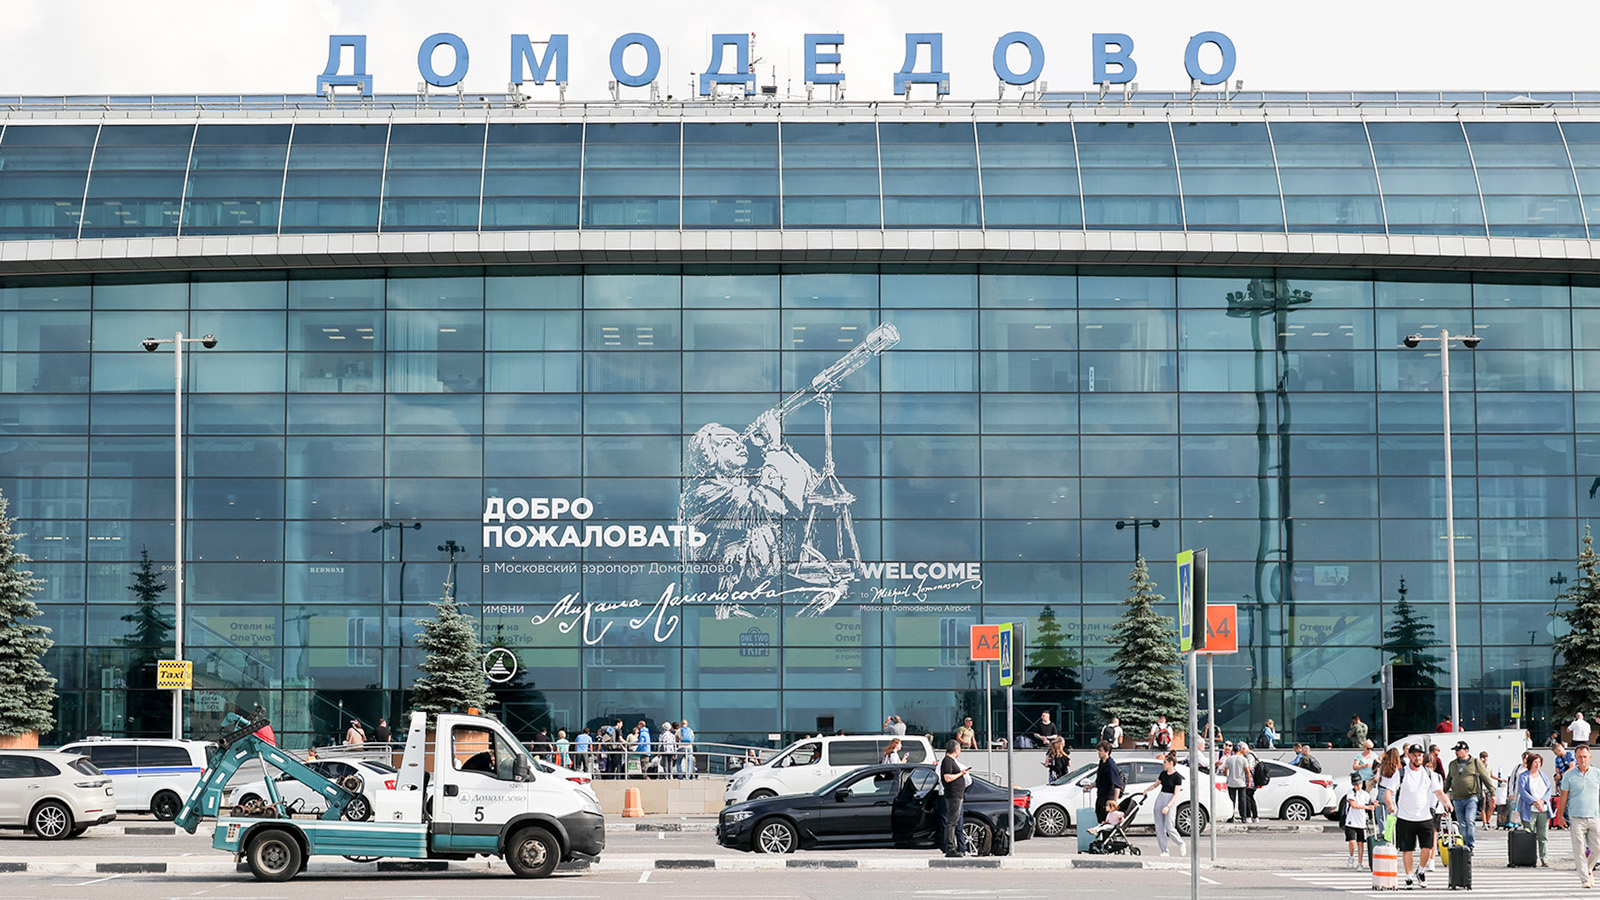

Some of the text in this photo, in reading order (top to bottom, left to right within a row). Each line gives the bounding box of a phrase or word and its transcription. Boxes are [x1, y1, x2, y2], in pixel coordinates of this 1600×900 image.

[317, 31, 1236, 97] ДОМОДЕДОВО
[483, 497, 594, 523] ДОБРО
[483, 525, 706, 548] ПОЖАЛОВАТЬ
[483, 562, 734, 577] в Московский аэропорт Домодедово
[861, 562, 981, 579] WELCOME
[482, 605, 524, 614] имени
[230, 622, 262, 630] Отели
[976, 634, 1000, 650] A2
[160, 670, 184, 679] Taxi
[474, 806, 485, 822] 5
